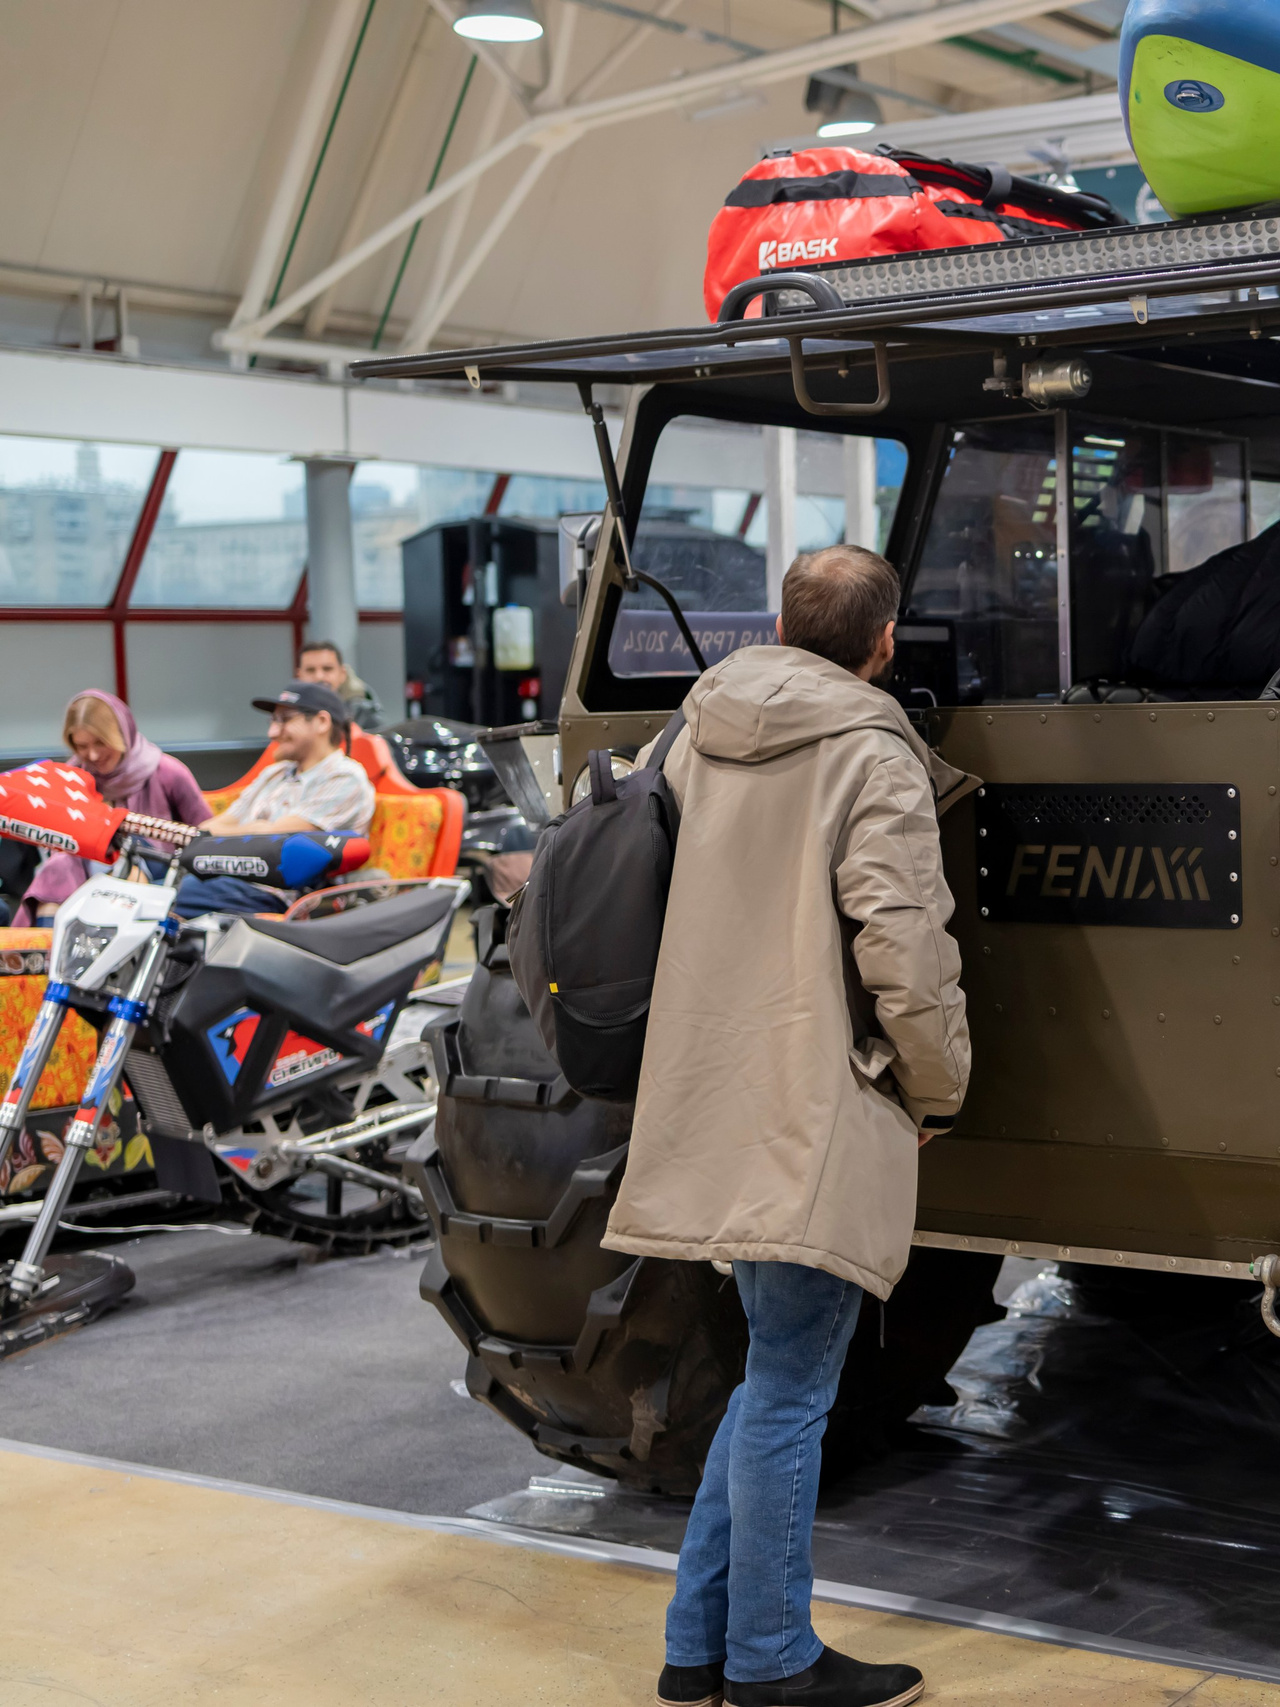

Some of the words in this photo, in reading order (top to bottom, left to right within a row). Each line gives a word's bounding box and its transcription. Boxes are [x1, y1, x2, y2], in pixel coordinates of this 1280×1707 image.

[777, 237, 839, 263] BASK
[0, 816, 77, 851] НЕГИРЬ
[194, 856, 268, 876] СНЕГИРЬ
